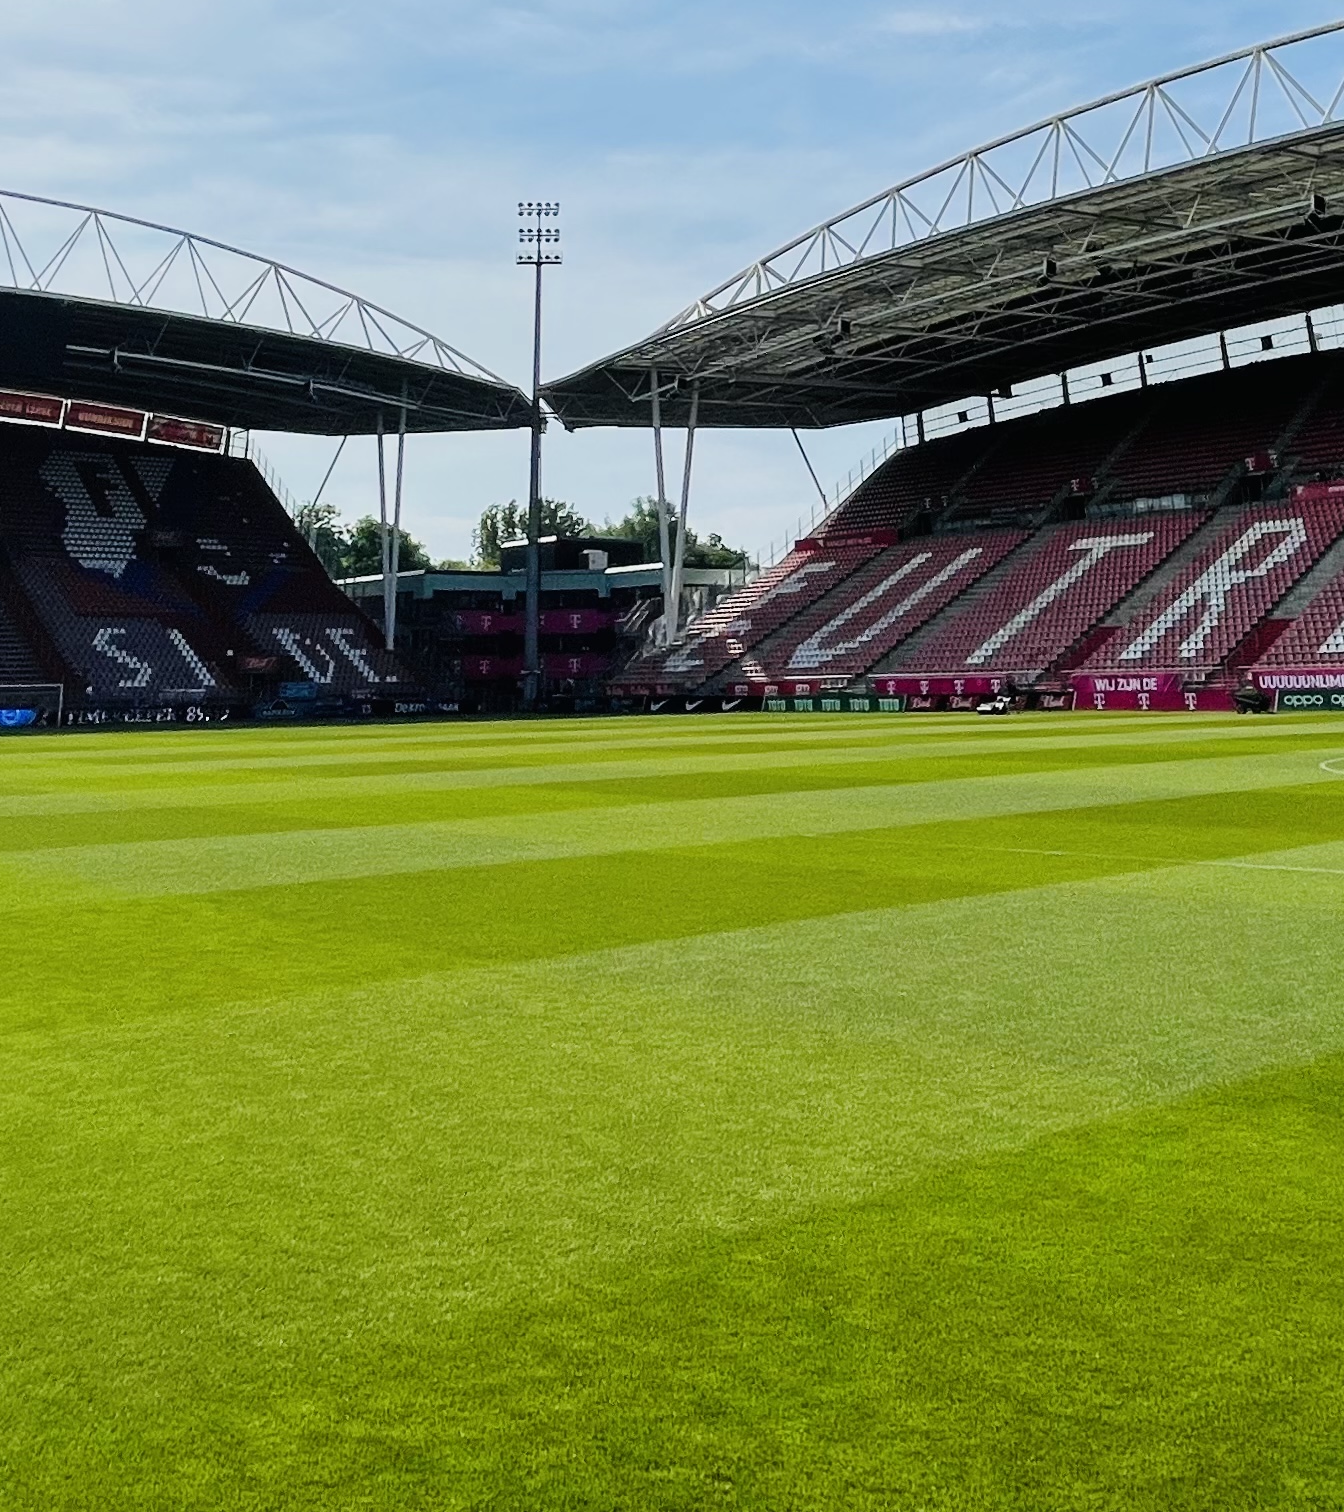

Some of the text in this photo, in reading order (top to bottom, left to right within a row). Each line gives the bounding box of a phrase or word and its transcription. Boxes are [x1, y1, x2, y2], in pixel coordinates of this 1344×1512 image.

[1094, 677, 1158, 692] WIJ ZIJN DE
[1283, 694, 1324, 707] oppo
